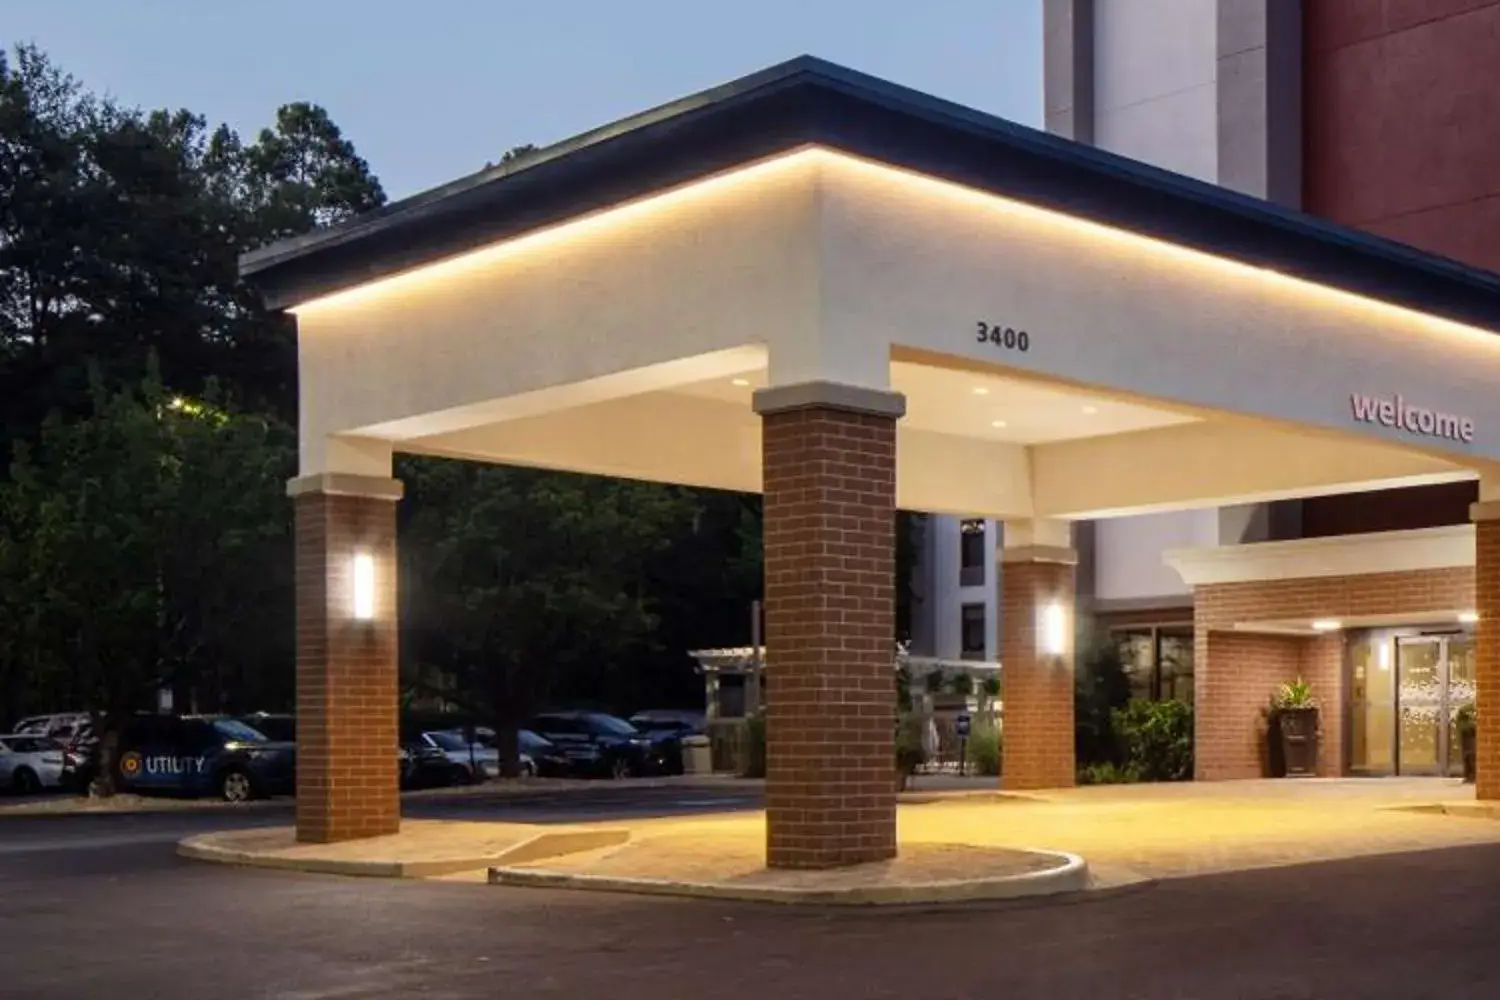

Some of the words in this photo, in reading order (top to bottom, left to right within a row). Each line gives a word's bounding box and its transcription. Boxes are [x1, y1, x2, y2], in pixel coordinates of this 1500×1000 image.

[976, 321, 1029, 352] 3400
[1350, 393, 1475, 443] welcome
[145, 755, 205, 775] UTILITY
